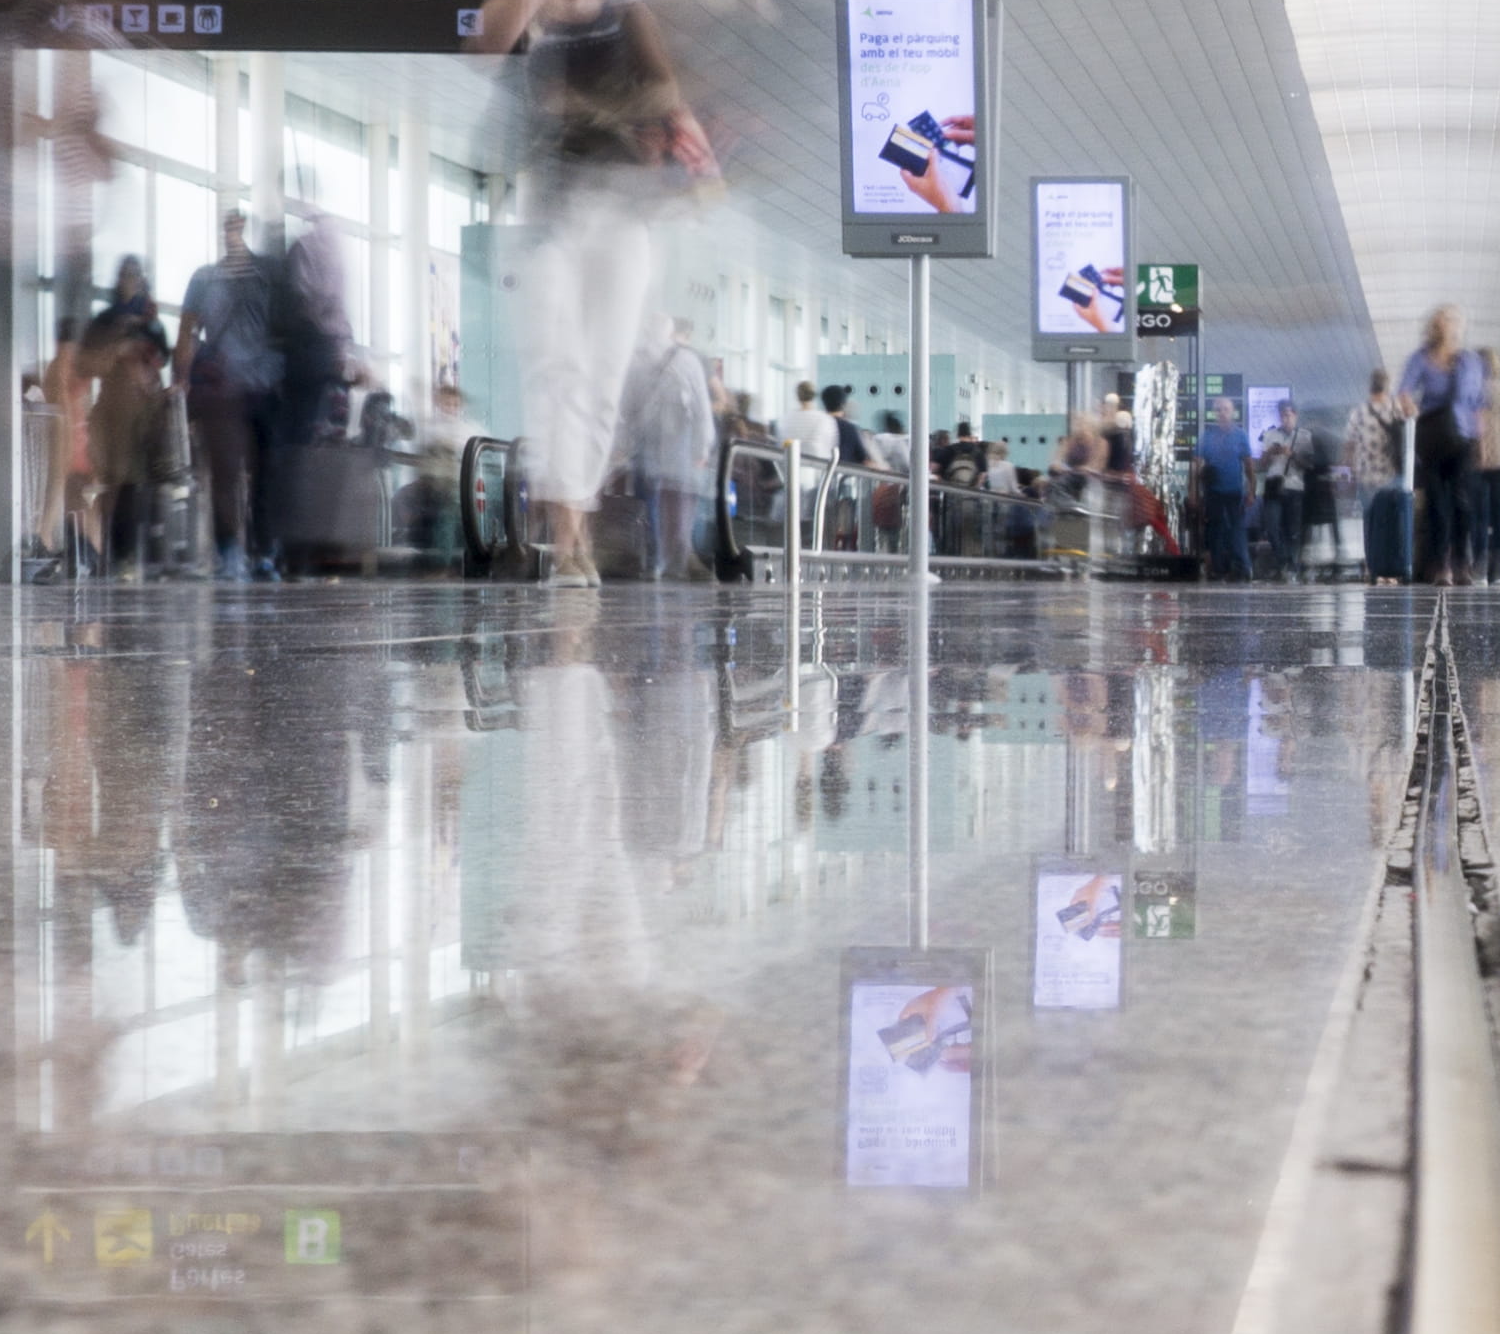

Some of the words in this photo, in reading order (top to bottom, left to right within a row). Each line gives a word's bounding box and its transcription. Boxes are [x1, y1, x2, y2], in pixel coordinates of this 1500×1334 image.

[860, 33, 889, 45] Paga
[892, 33, 903, 43] el
[860, 48, 885, 58] amb
[888, 48, 899, 58] el
[903, 48, 922, 58] teu
